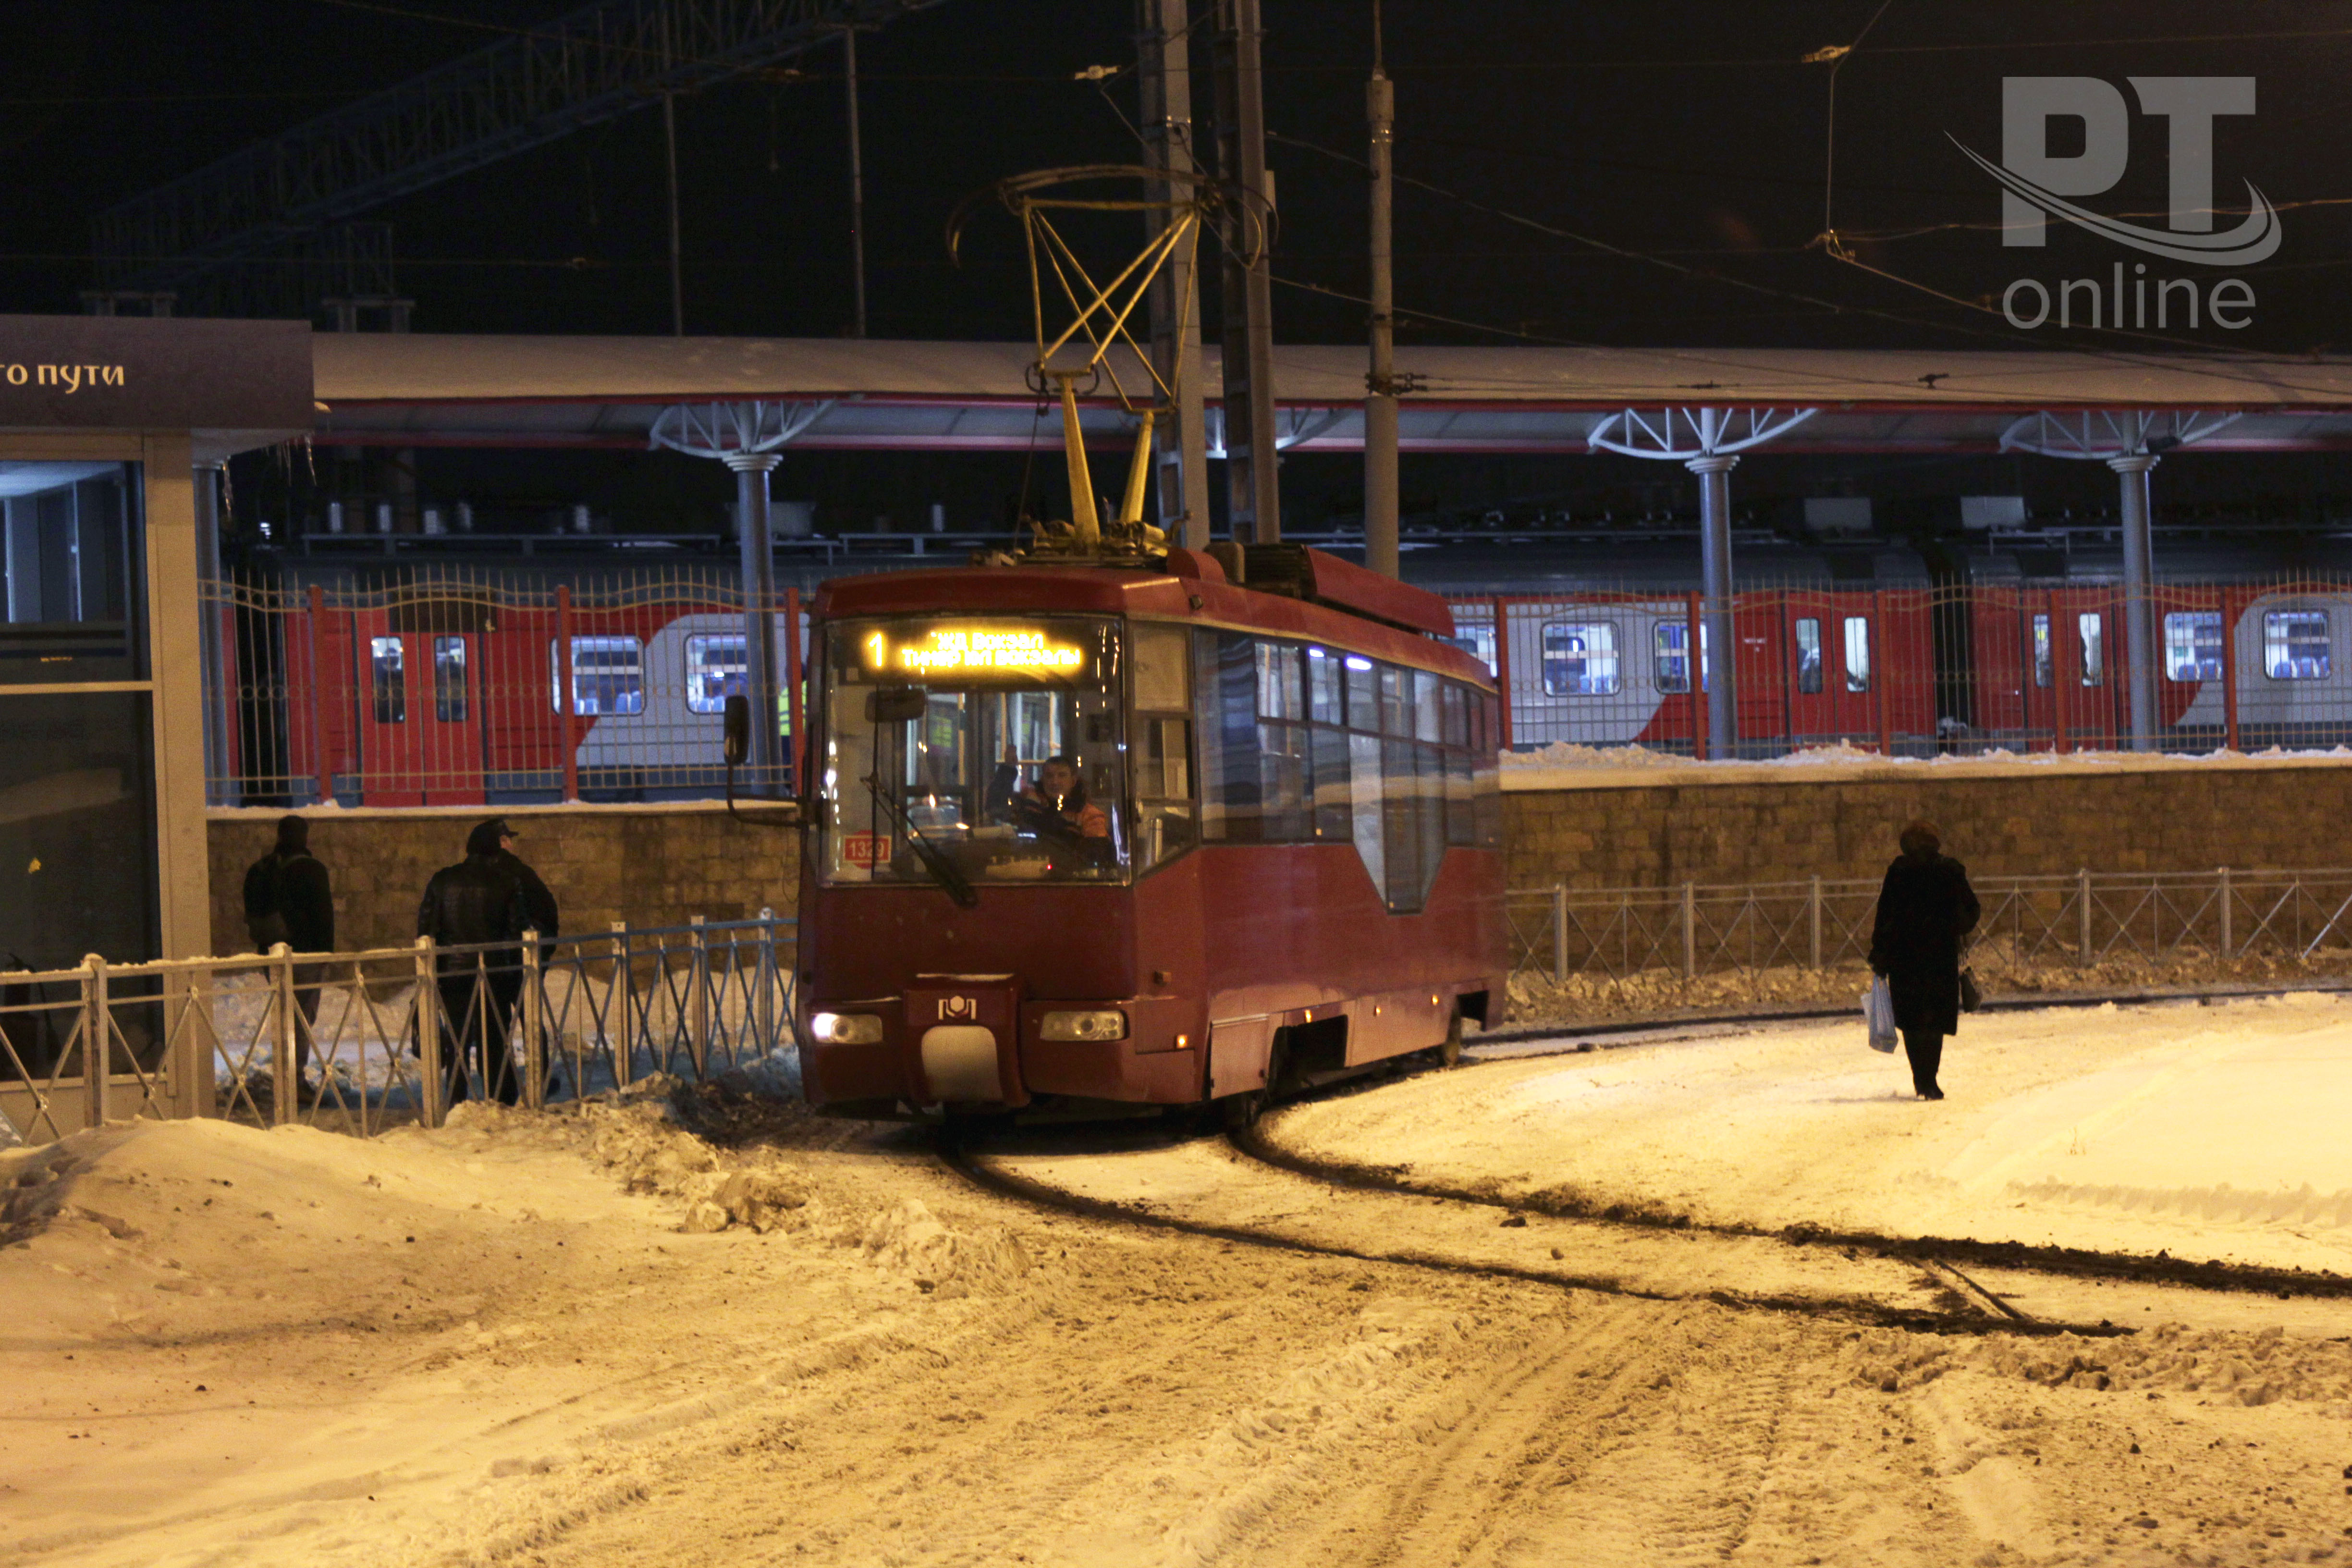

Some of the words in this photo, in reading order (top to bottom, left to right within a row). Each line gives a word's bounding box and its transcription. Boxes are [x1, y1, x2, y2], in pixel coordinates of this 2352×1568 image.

[0, 364, 28, 385] о
[37, 364, 125, 394] пути
[869, 633, 883, 667] 1
